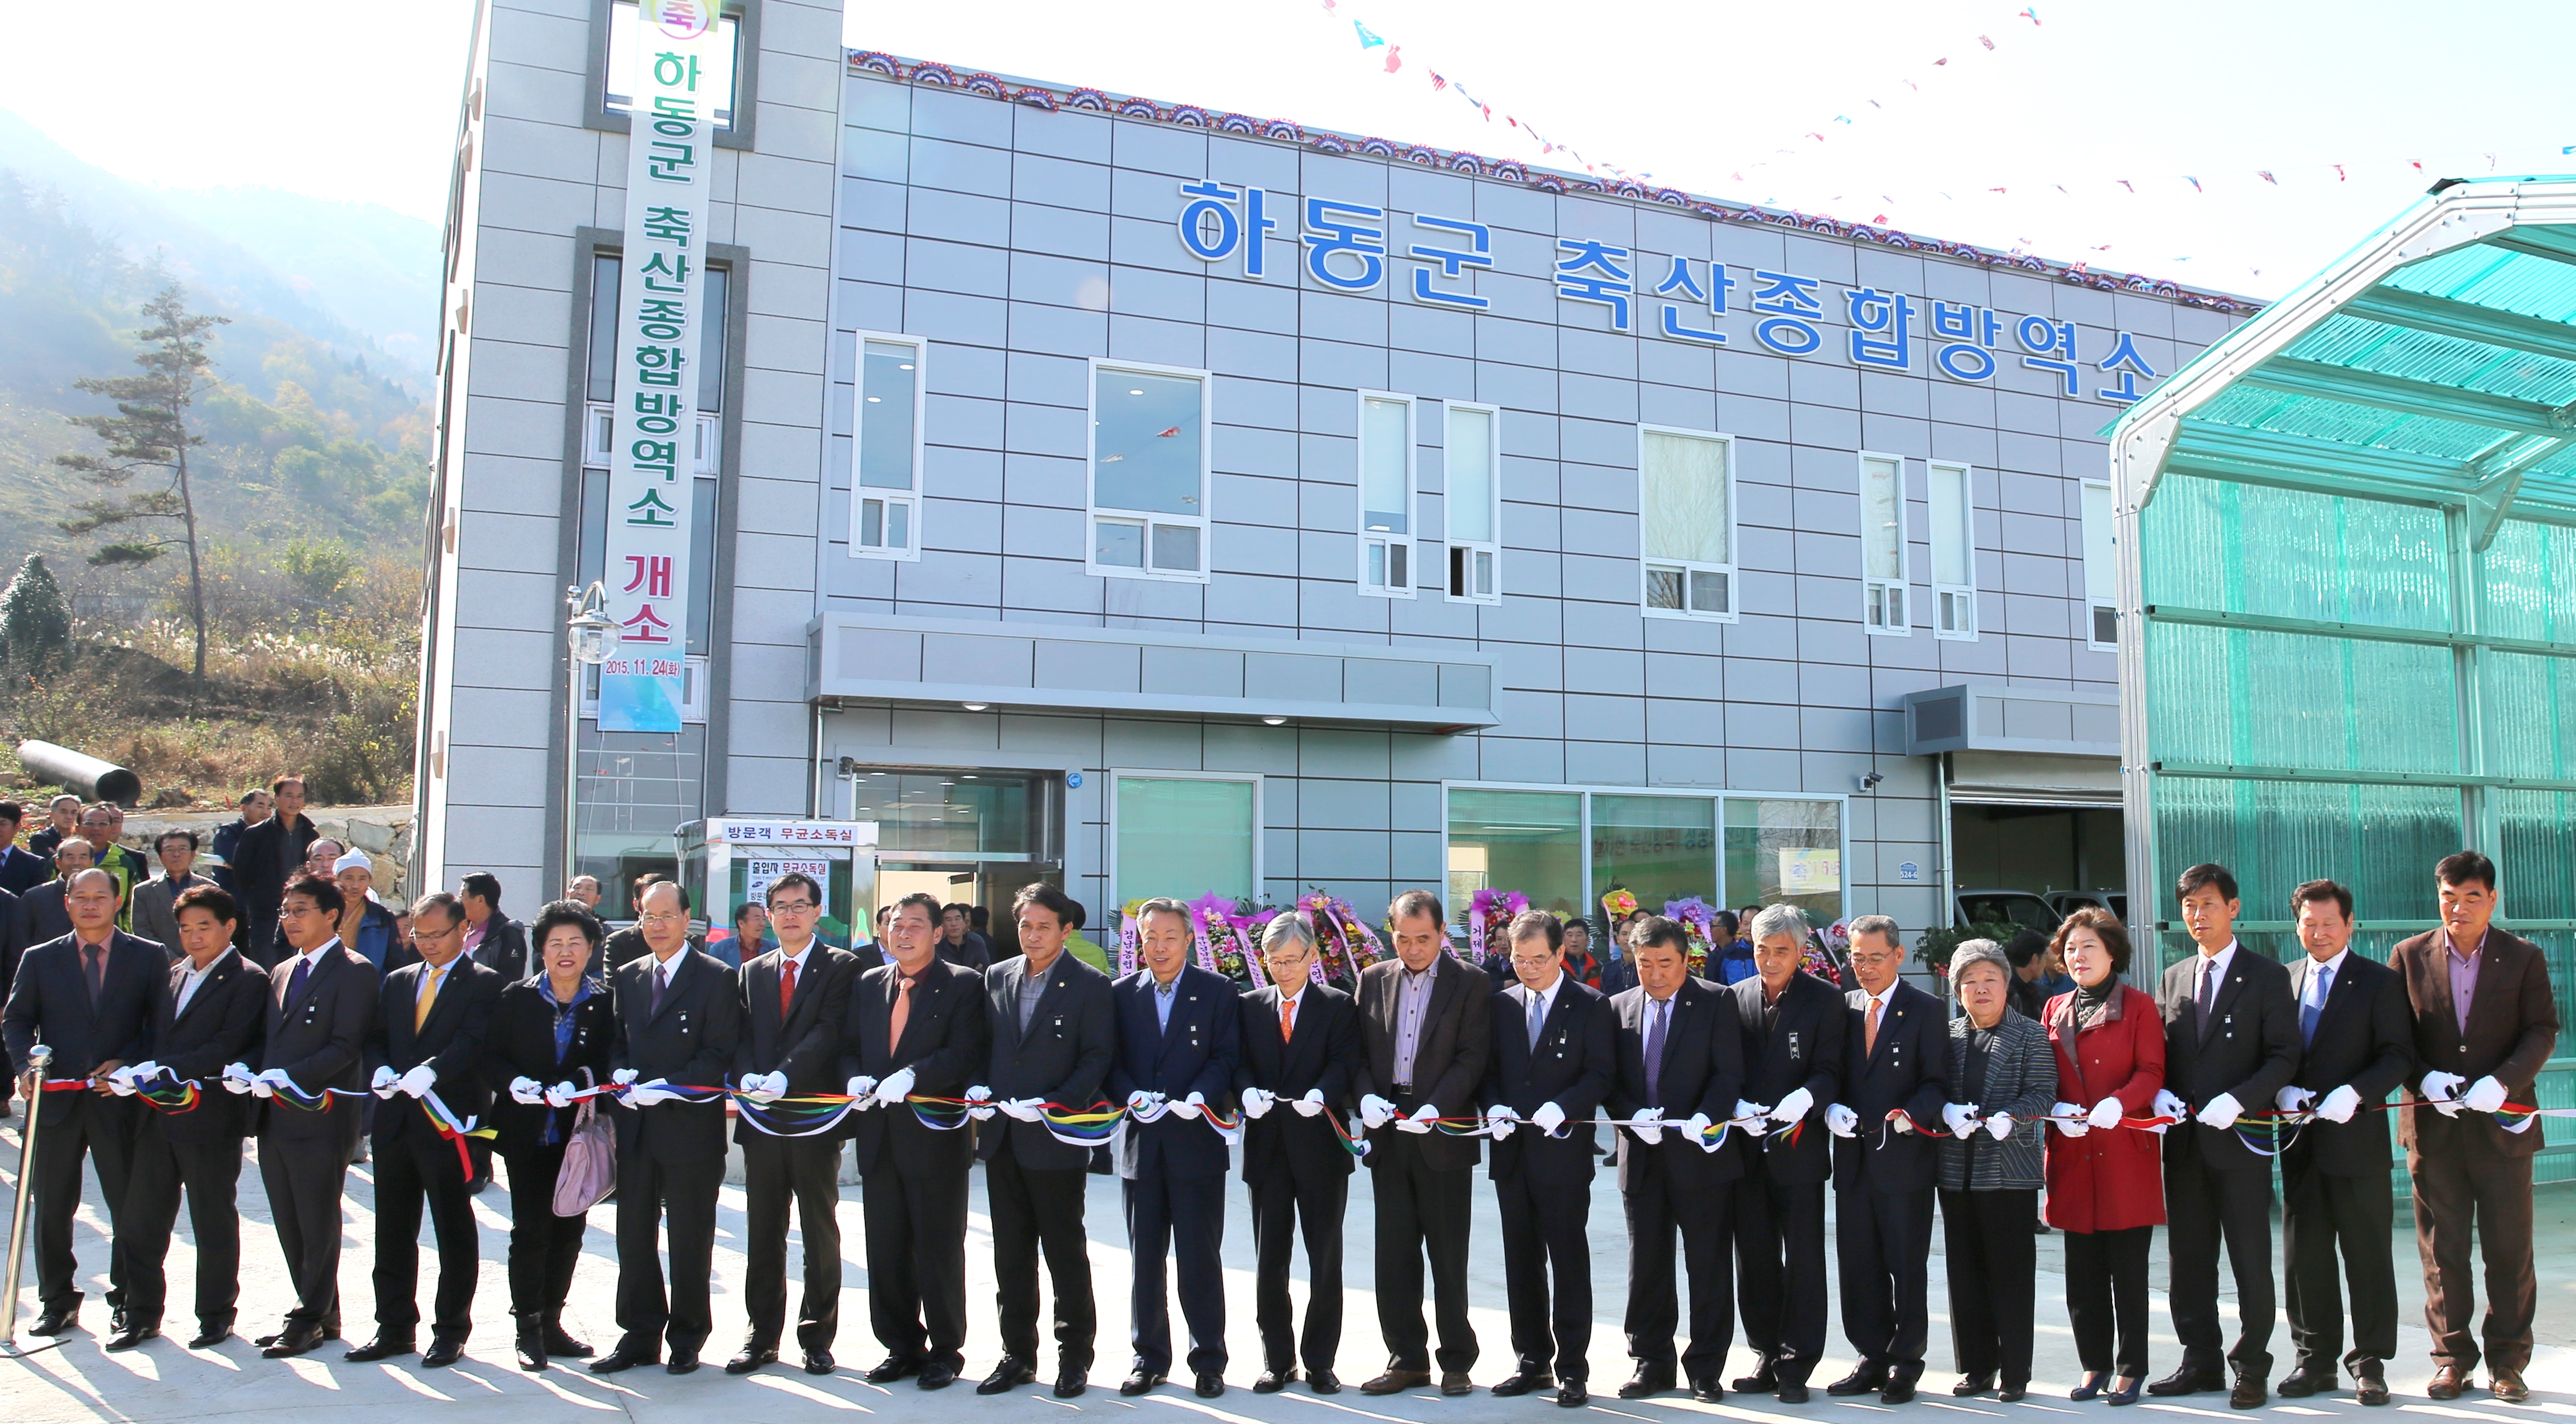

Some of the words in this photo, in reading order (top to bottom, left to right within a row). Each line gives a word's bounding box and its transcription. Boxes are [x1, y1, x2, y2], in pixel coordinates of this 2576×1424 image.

[648, 51, 702, 182] 하동군
[1177, 179, 1494, 310] 하동군
[1552, 237, 2157, 403] 축산종합방역소
[627, 206, 692, 526] 축산종합방역소
[621, 555, 672, 642] 개소
[606, 661, 630, 674] 2015.
[634, 659, 649, 675] 11.
[652, 659, 680, 677] 24(화)
[728, 826, 771, 839] 방문객
[780, 827, 852, 841] 무균소독실
[752, 862, 779, 874] 출입자
[783, 862, 826, 875] 무균소독실
[1901, 871, 1918, 879] 524-6
